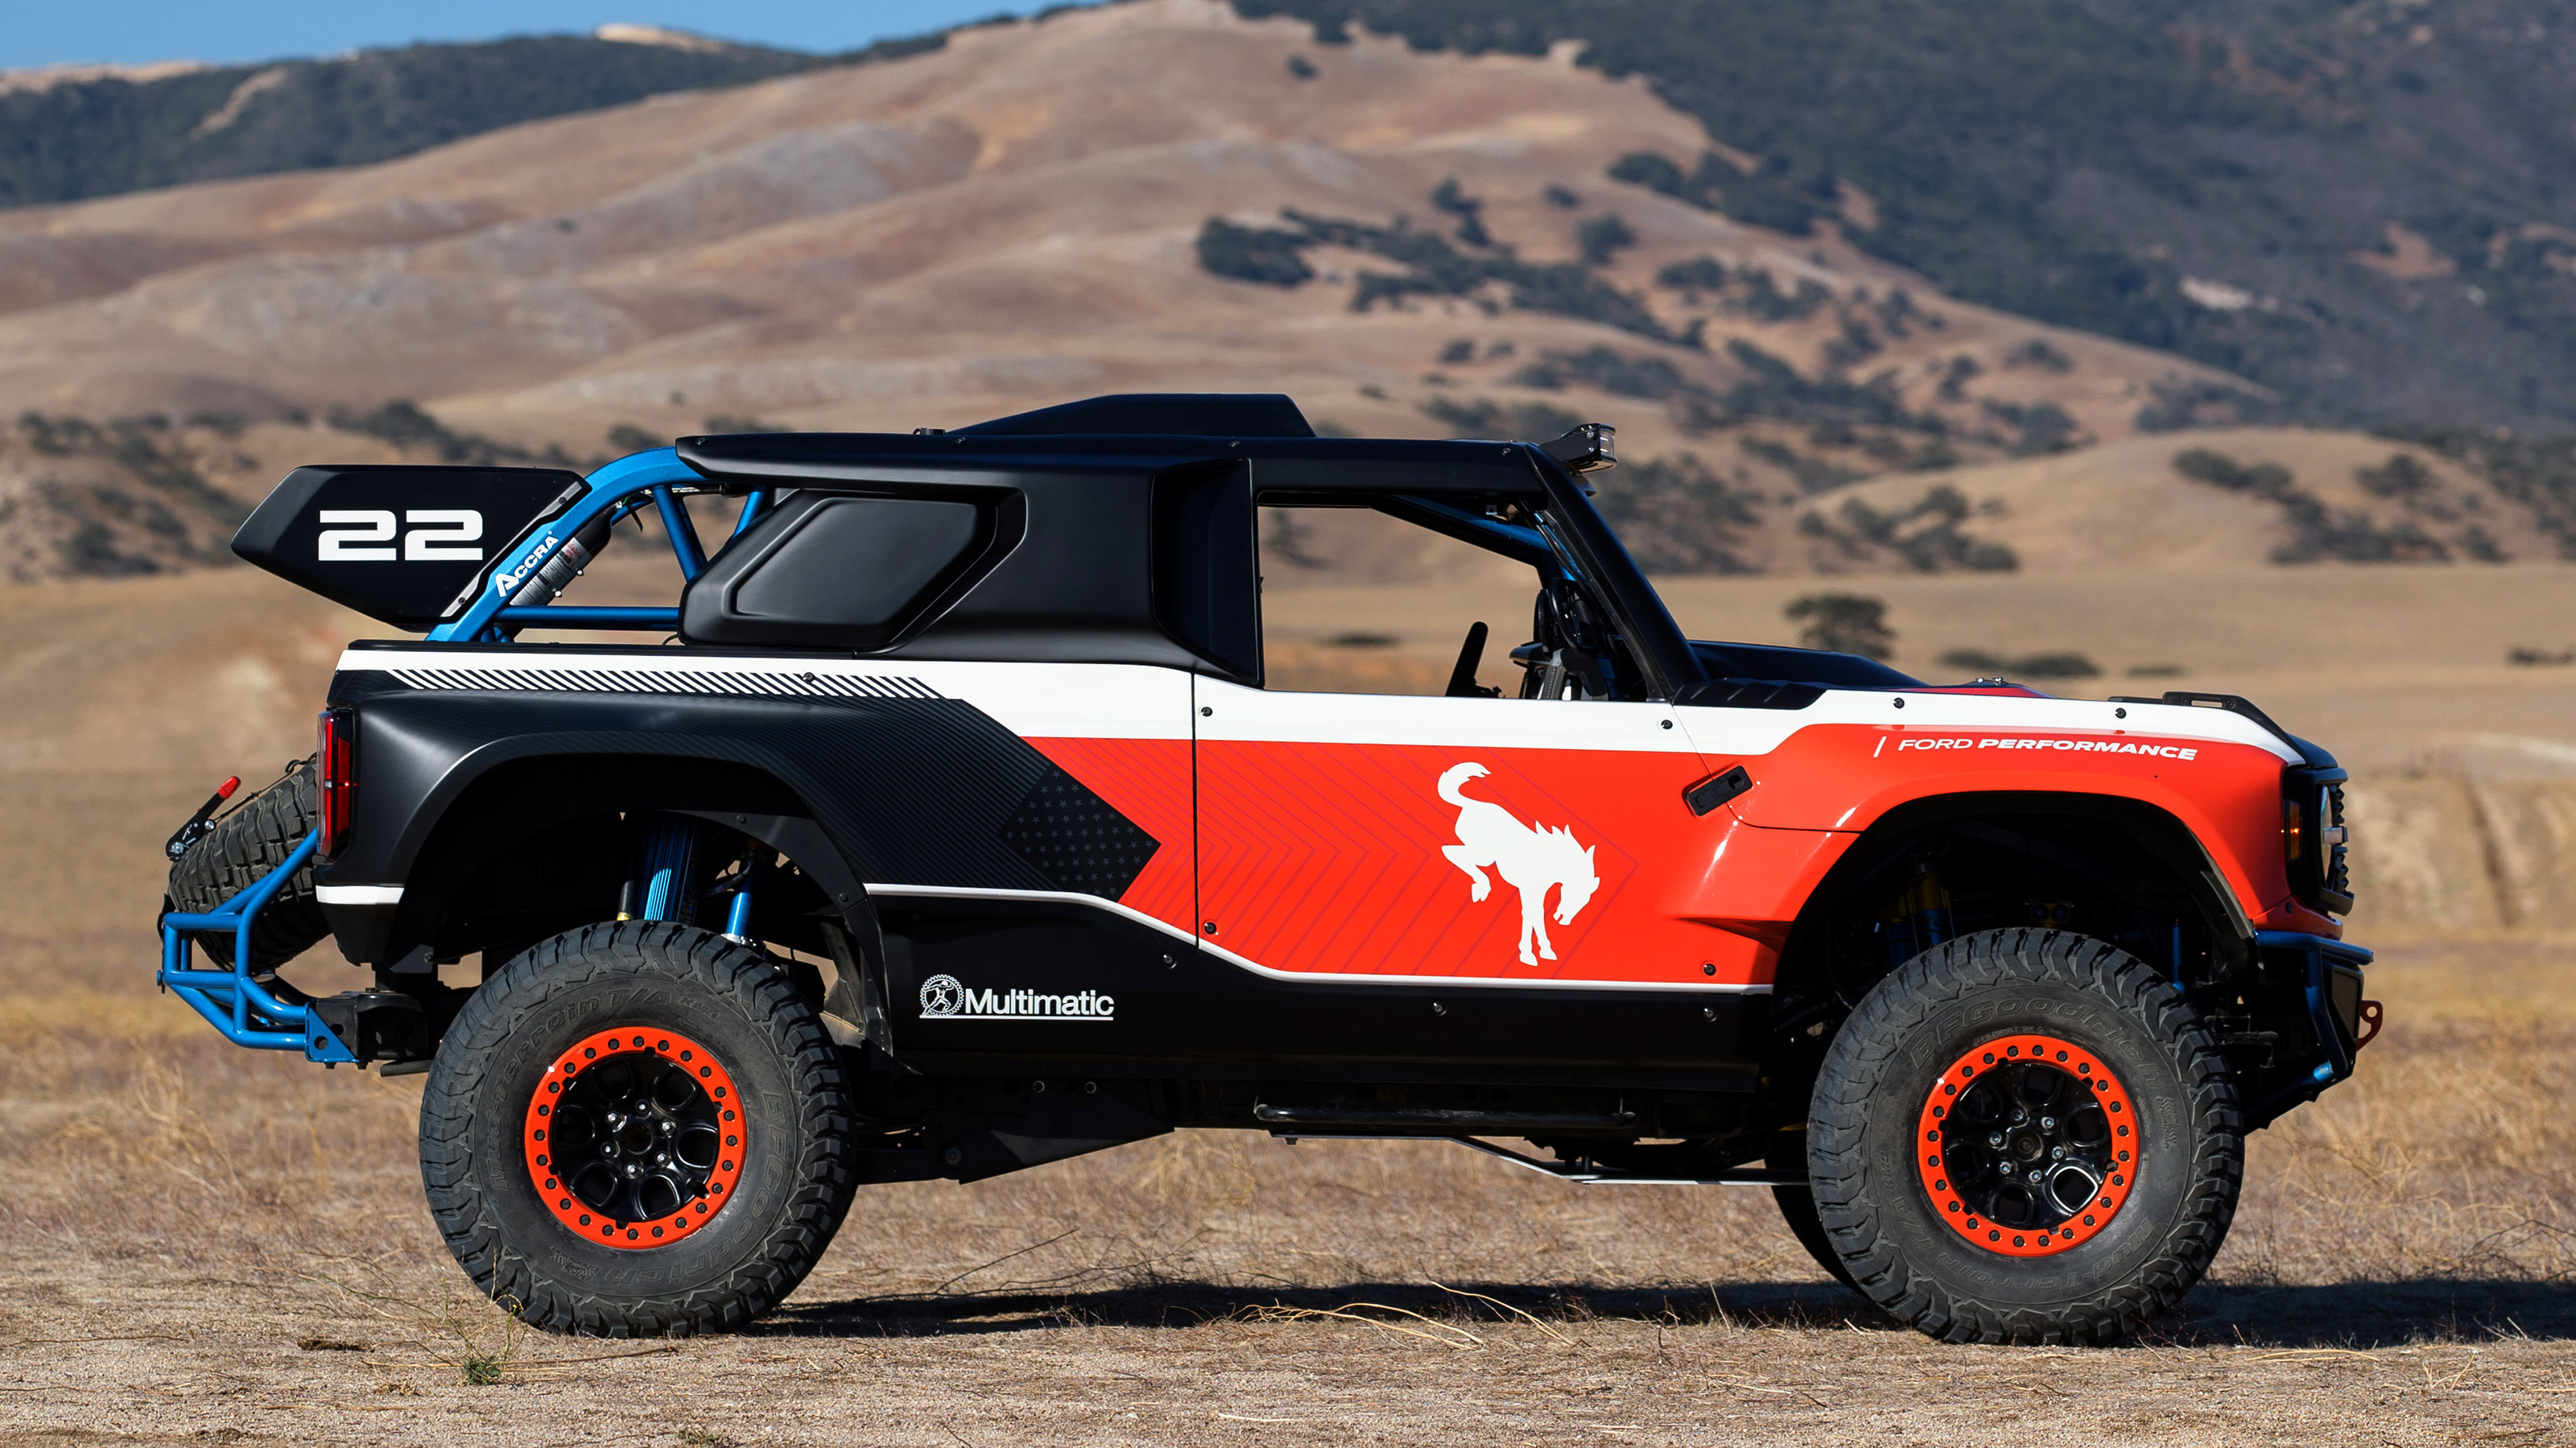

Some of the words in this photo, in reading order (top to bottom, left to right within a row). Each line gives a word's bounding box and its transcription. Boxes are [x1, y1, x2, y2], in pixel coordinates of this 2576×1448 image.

[318, 509, 483, 561] 22
[1897, 738, 1974, 751] FORD
[1977, 738, 2198, 761] PERFORMANCE
[965, 988, 1114, 1016] Multimatic
[1909, 996, 2164, 1091] BFGoodrich
[605, 1091, 793, 1286] BFGoodrich
